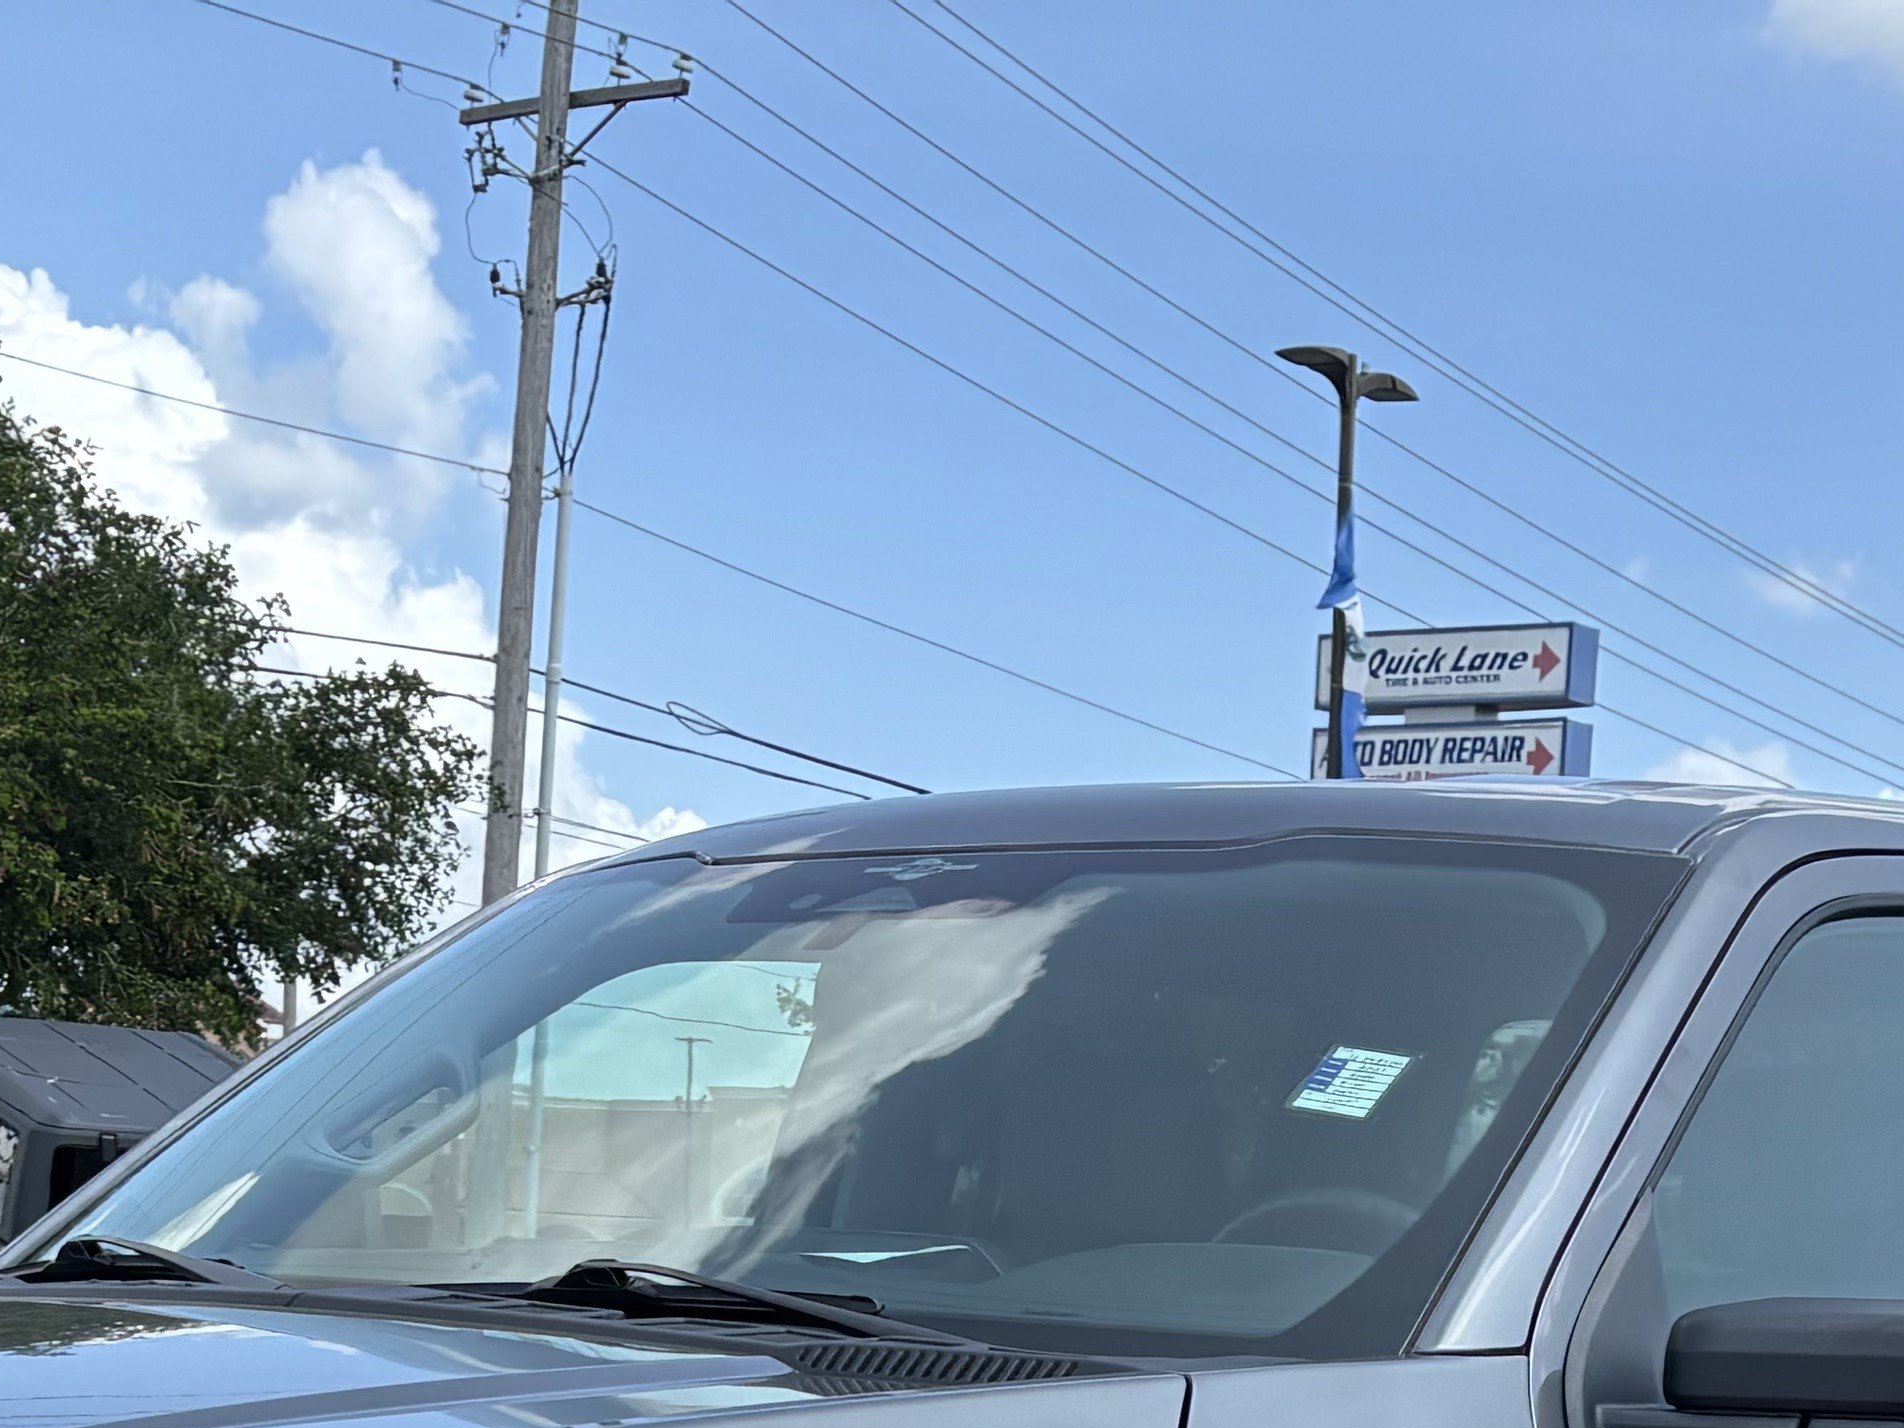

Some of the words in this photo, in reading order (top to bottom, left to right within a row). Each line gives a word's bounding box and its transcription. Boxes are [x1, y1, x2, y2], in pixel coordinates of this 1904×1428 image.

[1368, 646, 1447, 679] Quick
[1449, 645, 1529, 672] Lane
[1455, 674, 1501, 685] CENTER
[1378, 738, 1439, 767] BODY
[1440, 735, 1526, 765] REPAIR
